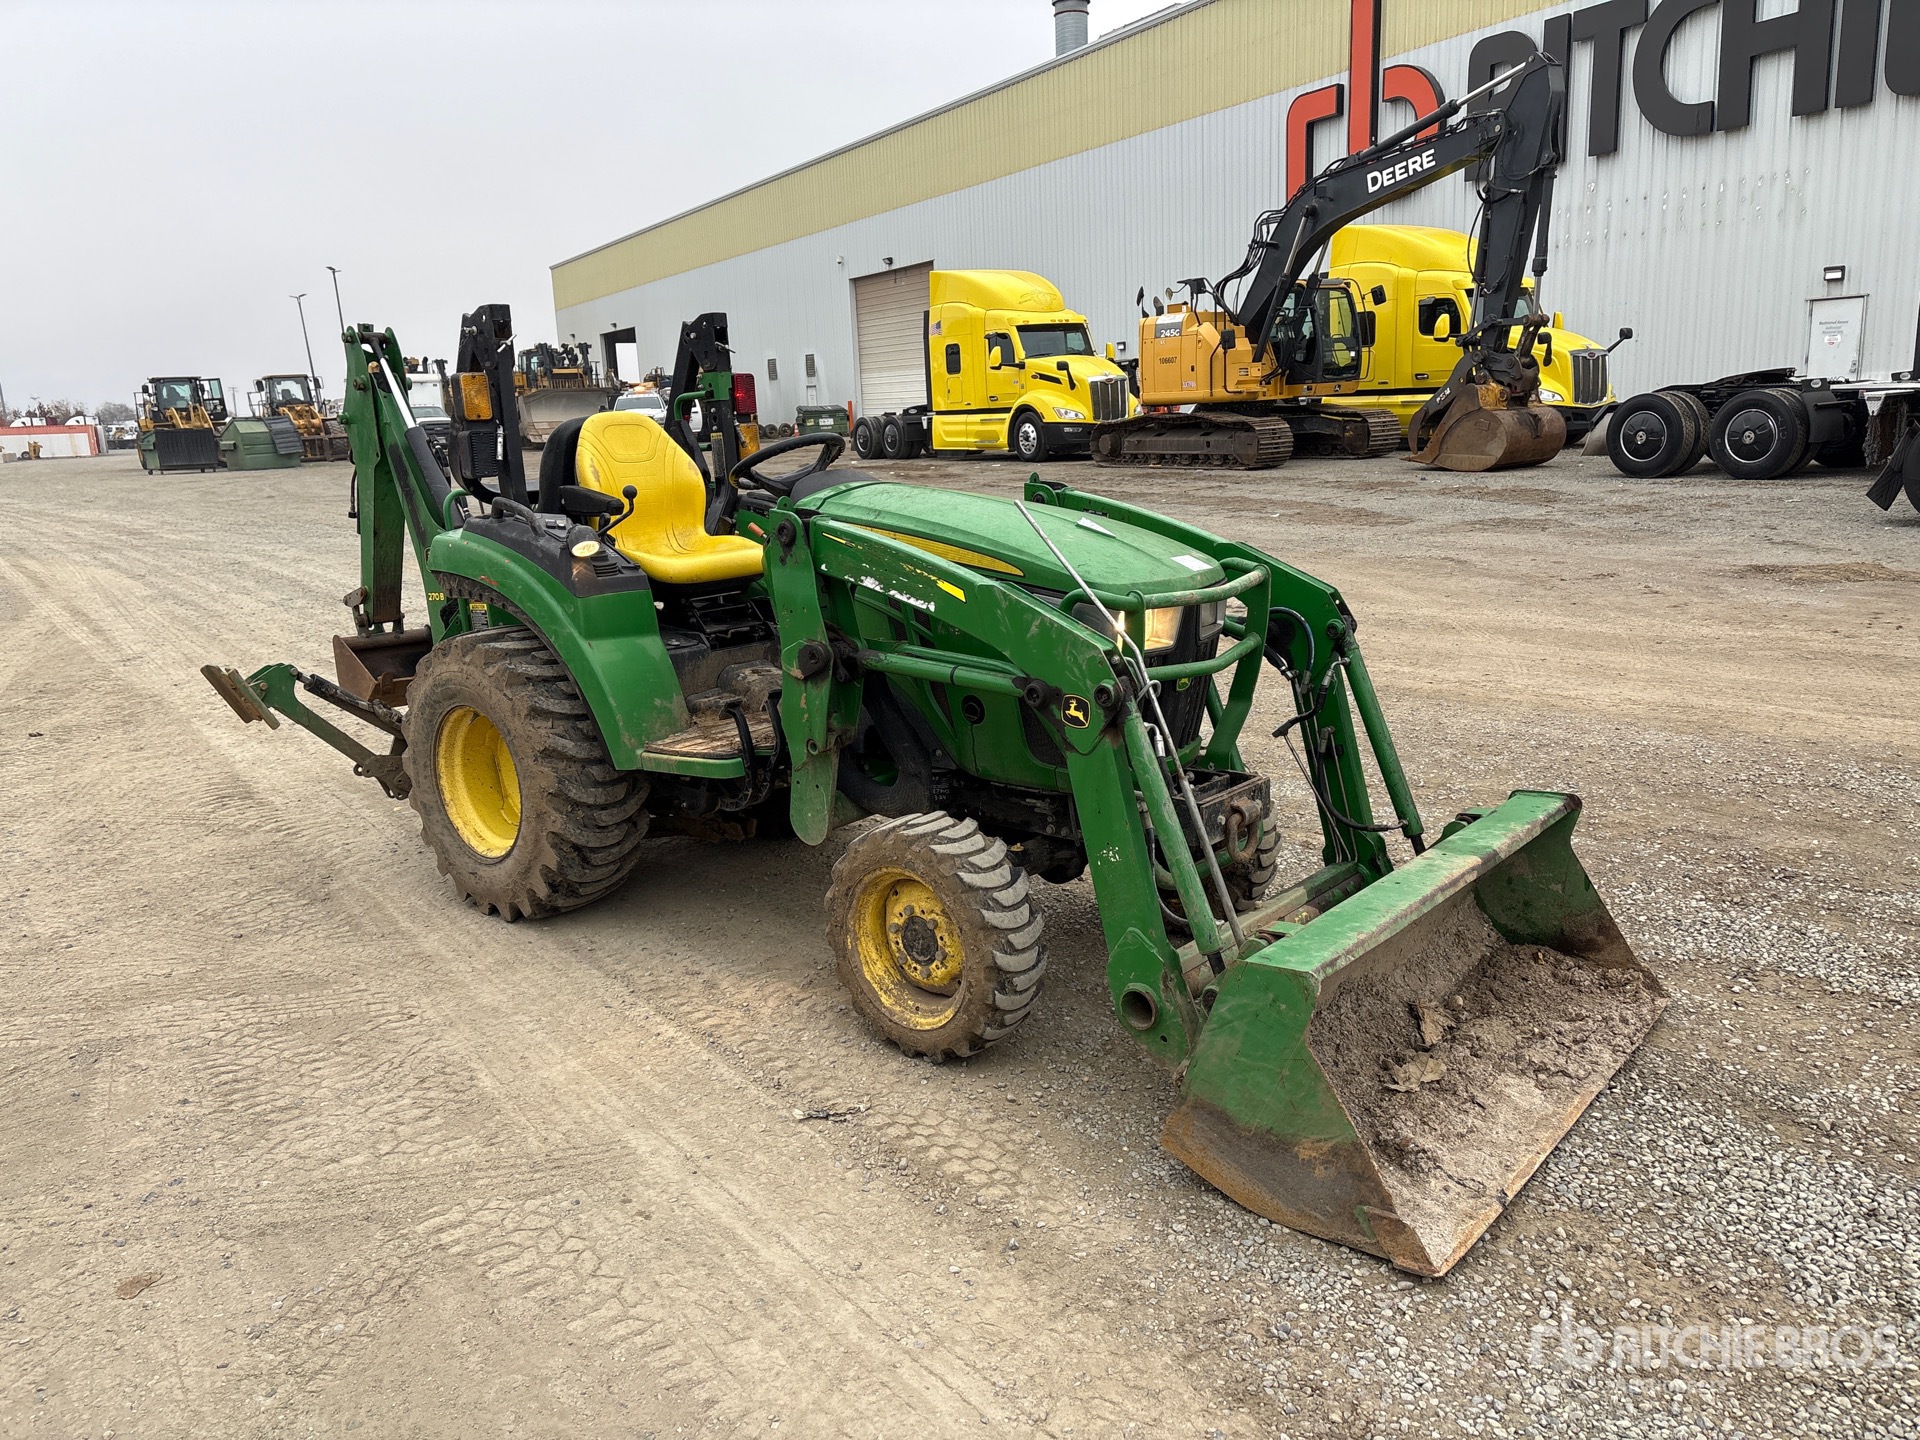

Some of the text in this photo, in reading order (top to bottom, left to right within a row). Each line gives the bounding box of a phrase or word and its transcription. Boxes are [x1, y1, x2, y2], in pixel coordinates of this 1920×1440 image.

[1464, 0, 1920, 182] RITCHI
[1366, 148, 1436, 194] DEERE
[1160, 328, 1180, 338] 245G
[1159, 356, 1178, 365] 106607
